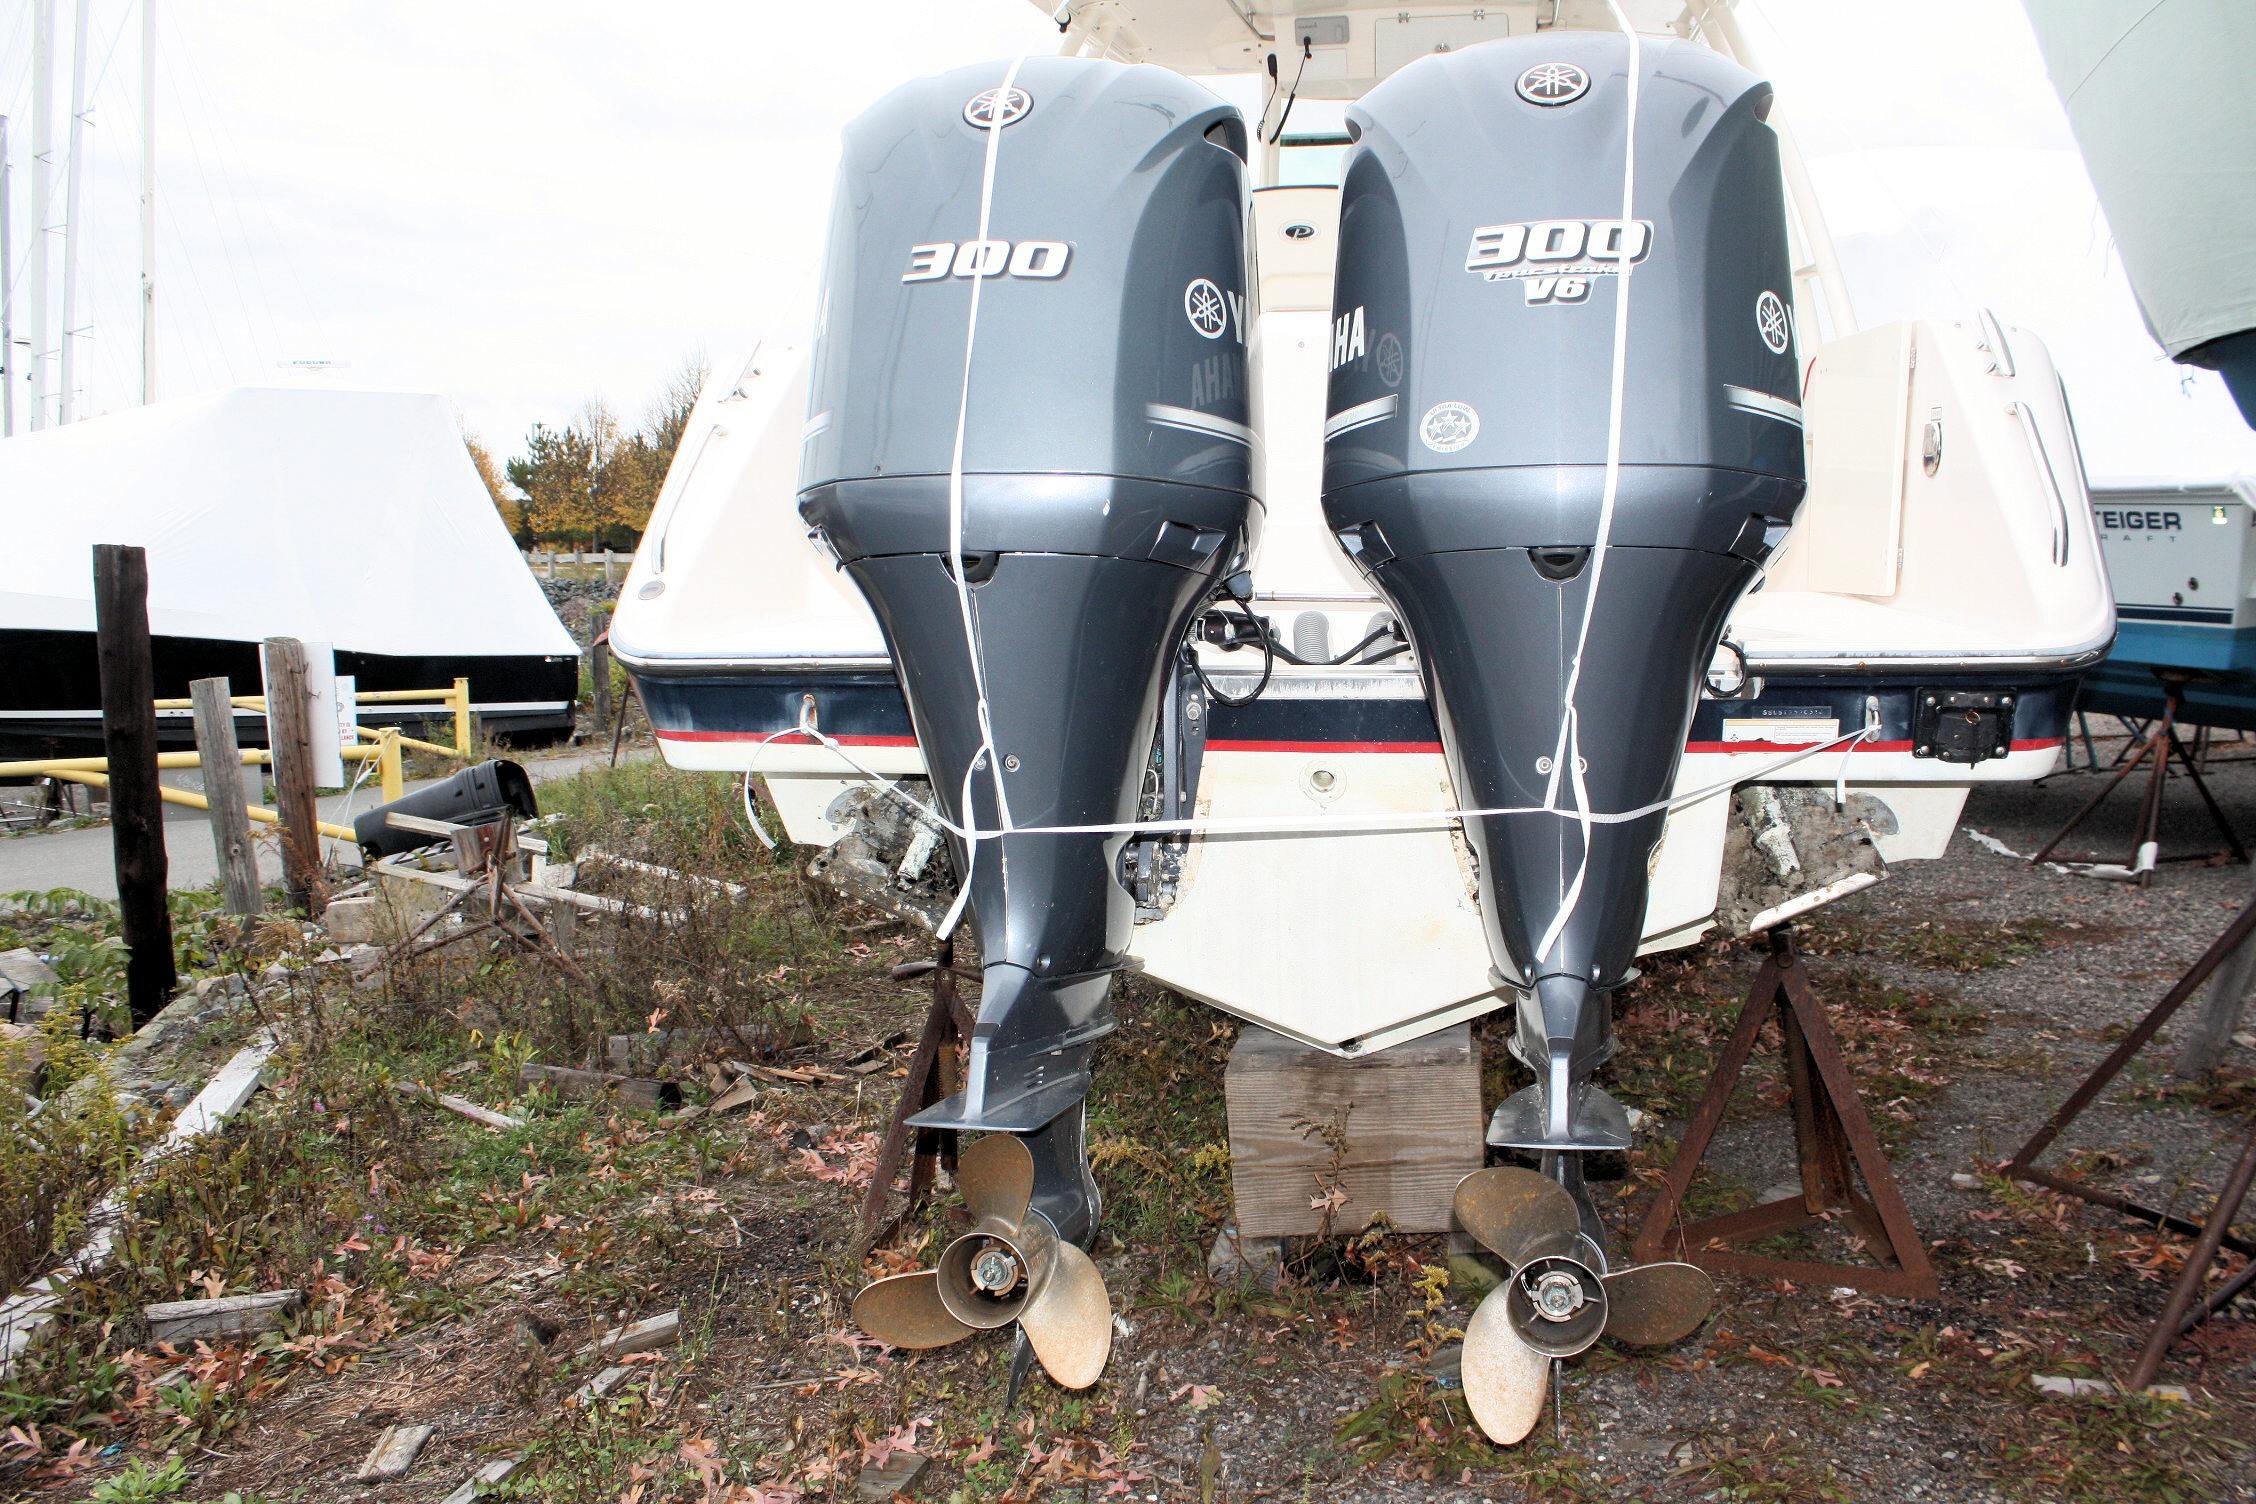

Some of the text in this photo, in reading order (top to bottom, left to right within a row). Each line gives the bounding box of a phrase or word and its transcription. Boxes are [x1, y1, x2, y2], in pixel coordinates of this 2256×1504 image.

[902, 240, 1070, 284] 300
[1467, 221, 1651, 271] 300
[1526, 276, 1591, 305] V6
